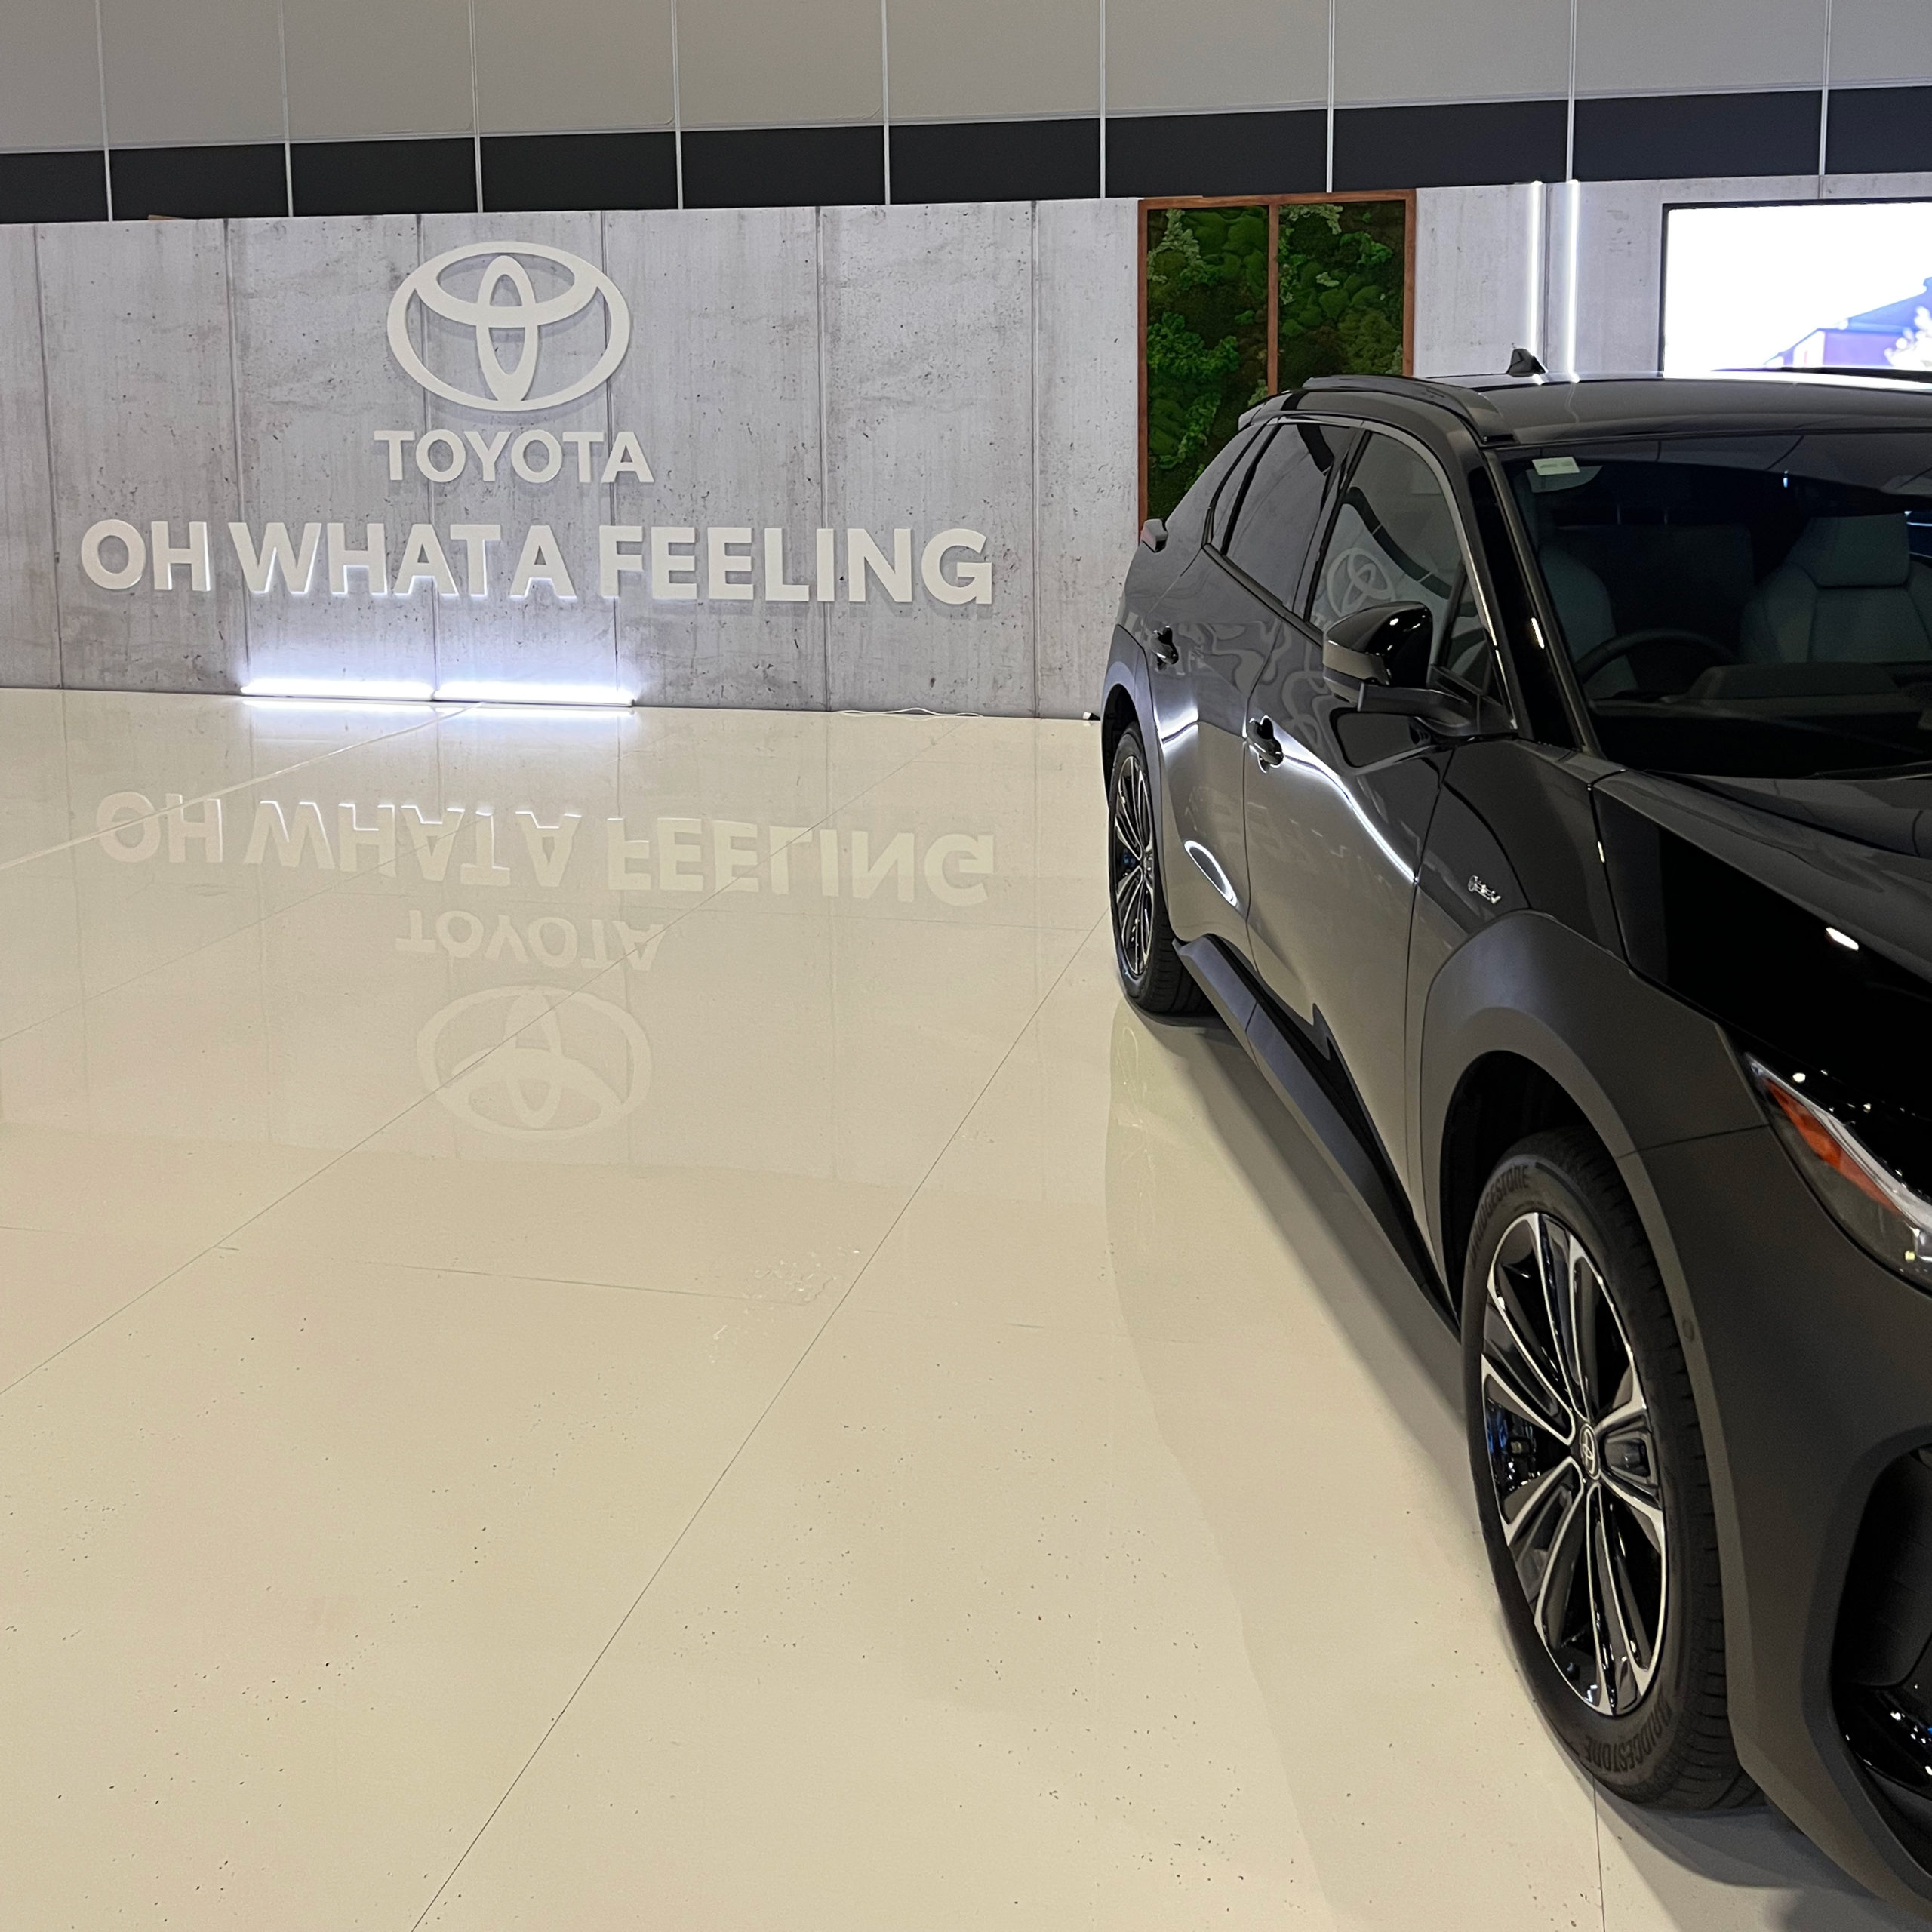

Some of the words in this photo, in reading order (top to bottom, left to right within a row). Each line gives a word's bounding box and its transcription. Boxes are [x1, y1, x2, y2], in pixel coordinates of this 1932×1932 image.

[374, 429, 654, 483] TOYOTA
[80, 519, 211, 591] OH
[228, 521, 501, 597] WHAT
[509, 525, 577, 599] A
[600, 525, 993, 605] FEELING
